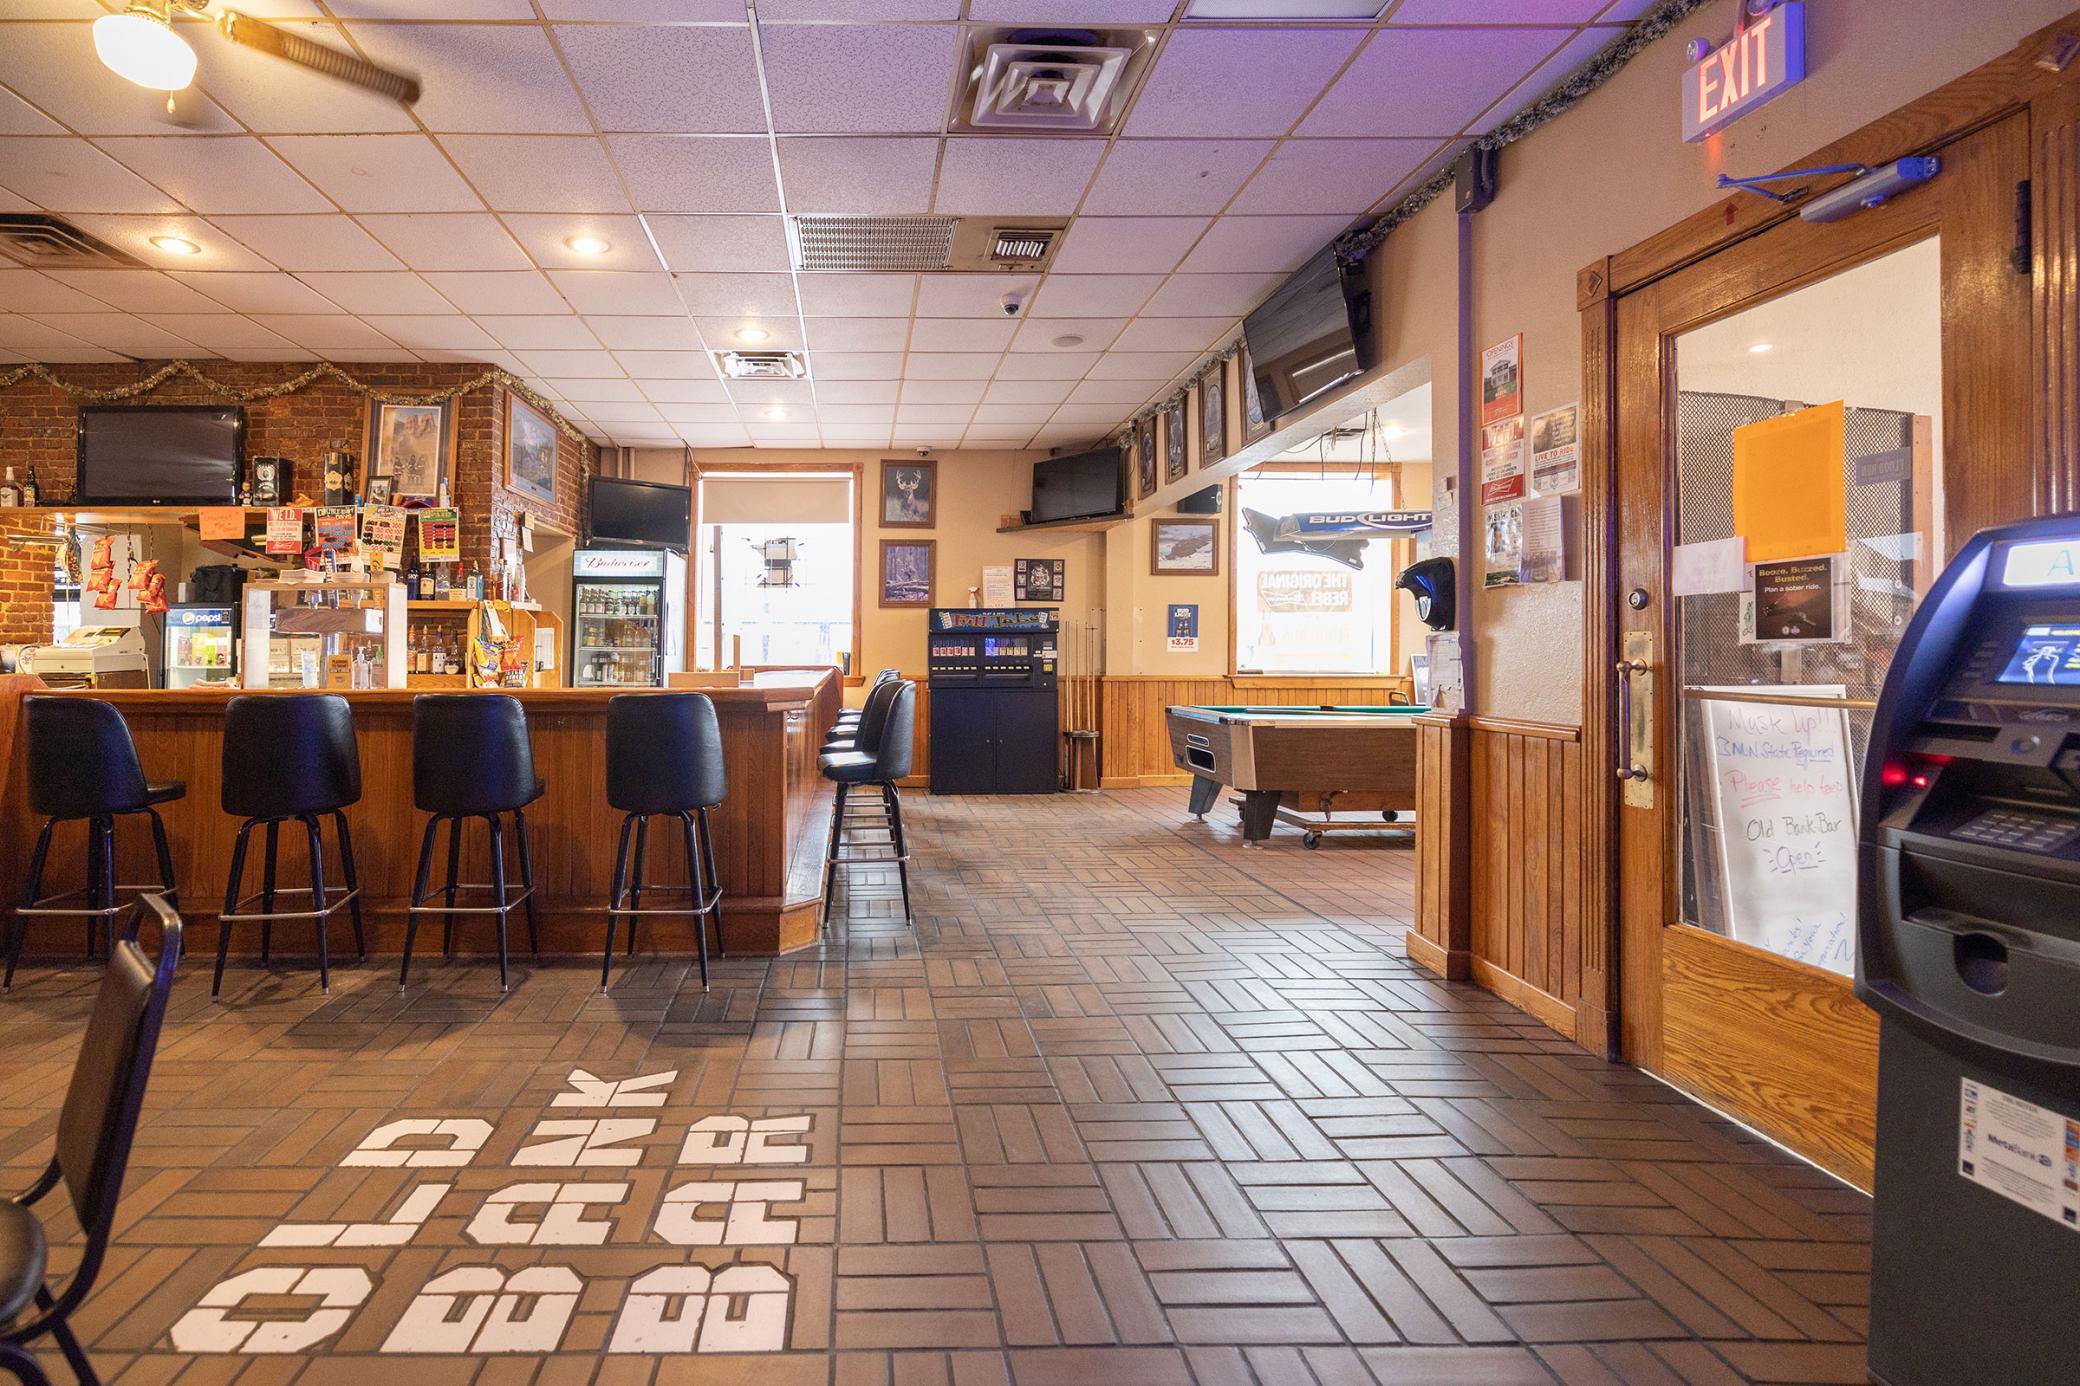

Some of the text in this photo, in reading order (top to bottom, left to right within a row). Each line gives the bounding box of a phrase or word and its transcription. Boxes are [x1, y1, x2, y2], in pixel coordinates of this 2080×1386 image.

[1699, 16, 1772, 123] EXIT
[1535, 453, 1548, 462] LIVE
[1309, 513, 1431, 524] BUD LIGHT
[584, 557, 650, 569] Budweiser
[1759, 564, 1827, 577] Booze. Buzzed.
[1775, 574, 1809, 583] Busted.
[195, 613, 222, 624] pepsi
[1171, 638, 1194, 646] $3.75
[1728, 707, 1788, 735] Mask
[1724, 768, 1782, 793] Please
[1747, 811, 1842, 841] Old Bank Bar
[1776, 845, 1813, 876] Open
[379, 1067, 678, 1355] BANK
[168, 1118, 494, 1354] OLD
[607, 1114, 814, 1355] BAR
